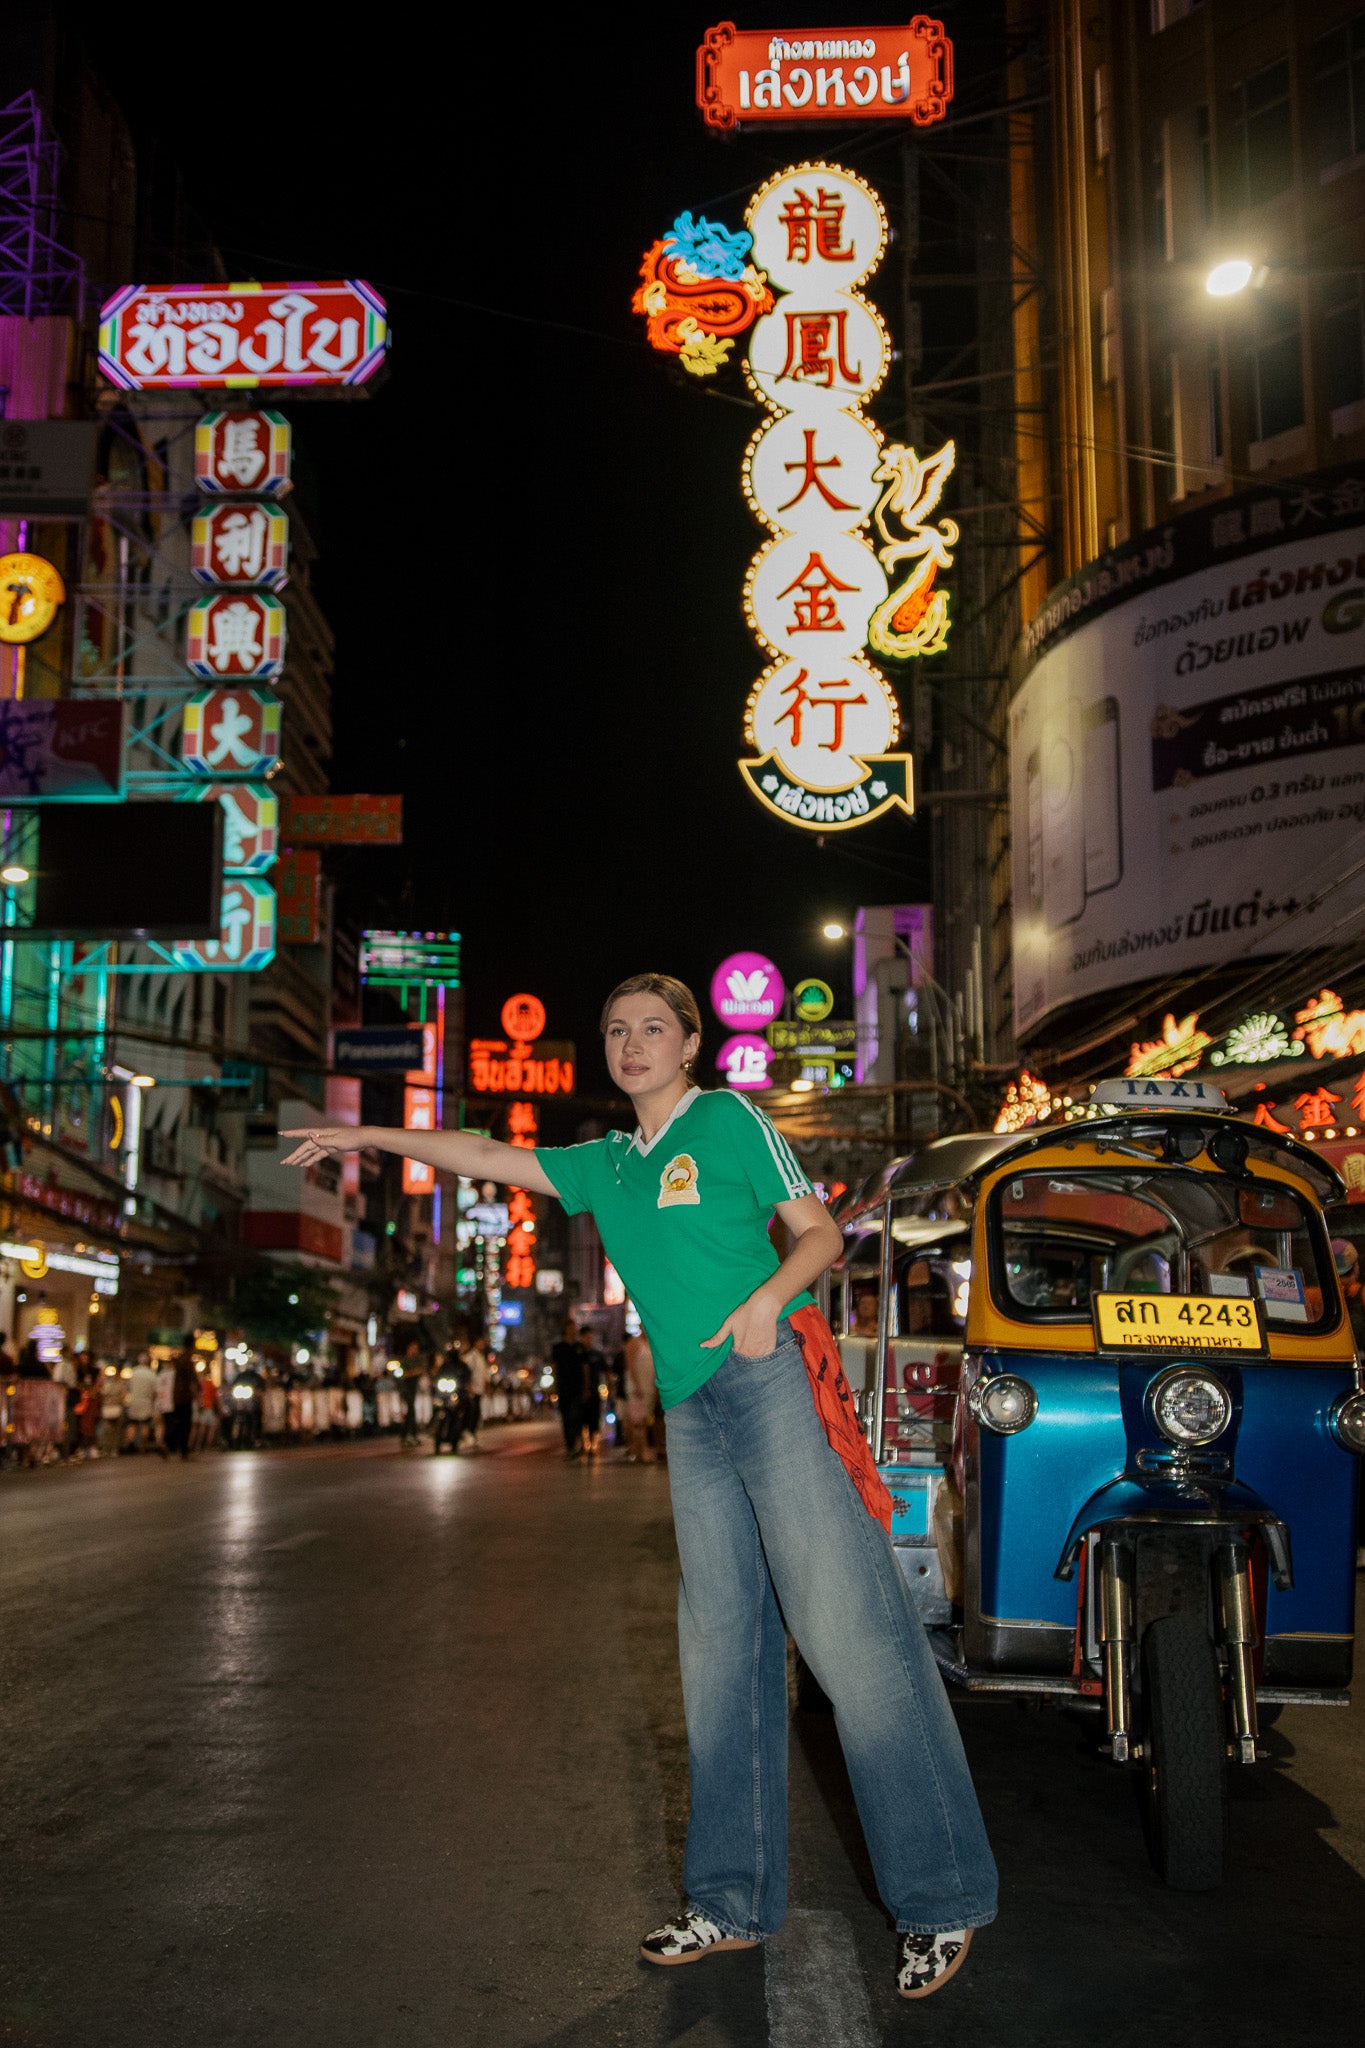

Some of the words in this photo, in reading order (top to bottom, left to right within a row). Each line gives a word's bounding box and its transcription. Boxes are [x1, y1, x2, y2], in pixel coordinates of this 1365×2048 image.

[768, 36, 876, 61] ห้างขายทอง
[739, 51, 911, 109] เล่งหงษ์
[136, 296, 244, 324] ห้างทอง
[125, 293, 361, 376] ทองใบ
[776, 188, 868, 752] 龍鳳大金行
[1175, 617, 1312, 676] ด้วยแอพ
[774, 783, 870, 822] เล่งหงษ์
[1250, 783, 1280, 804] 0.3
[1121, 1079, 1206, 1099] TAXI
[1115, 1299, 1160, 1325] สก
[1178, 1302, 1252, 1327] 4243
[1122, 1333, 1243, 1348] กรงเทพมหานคร
